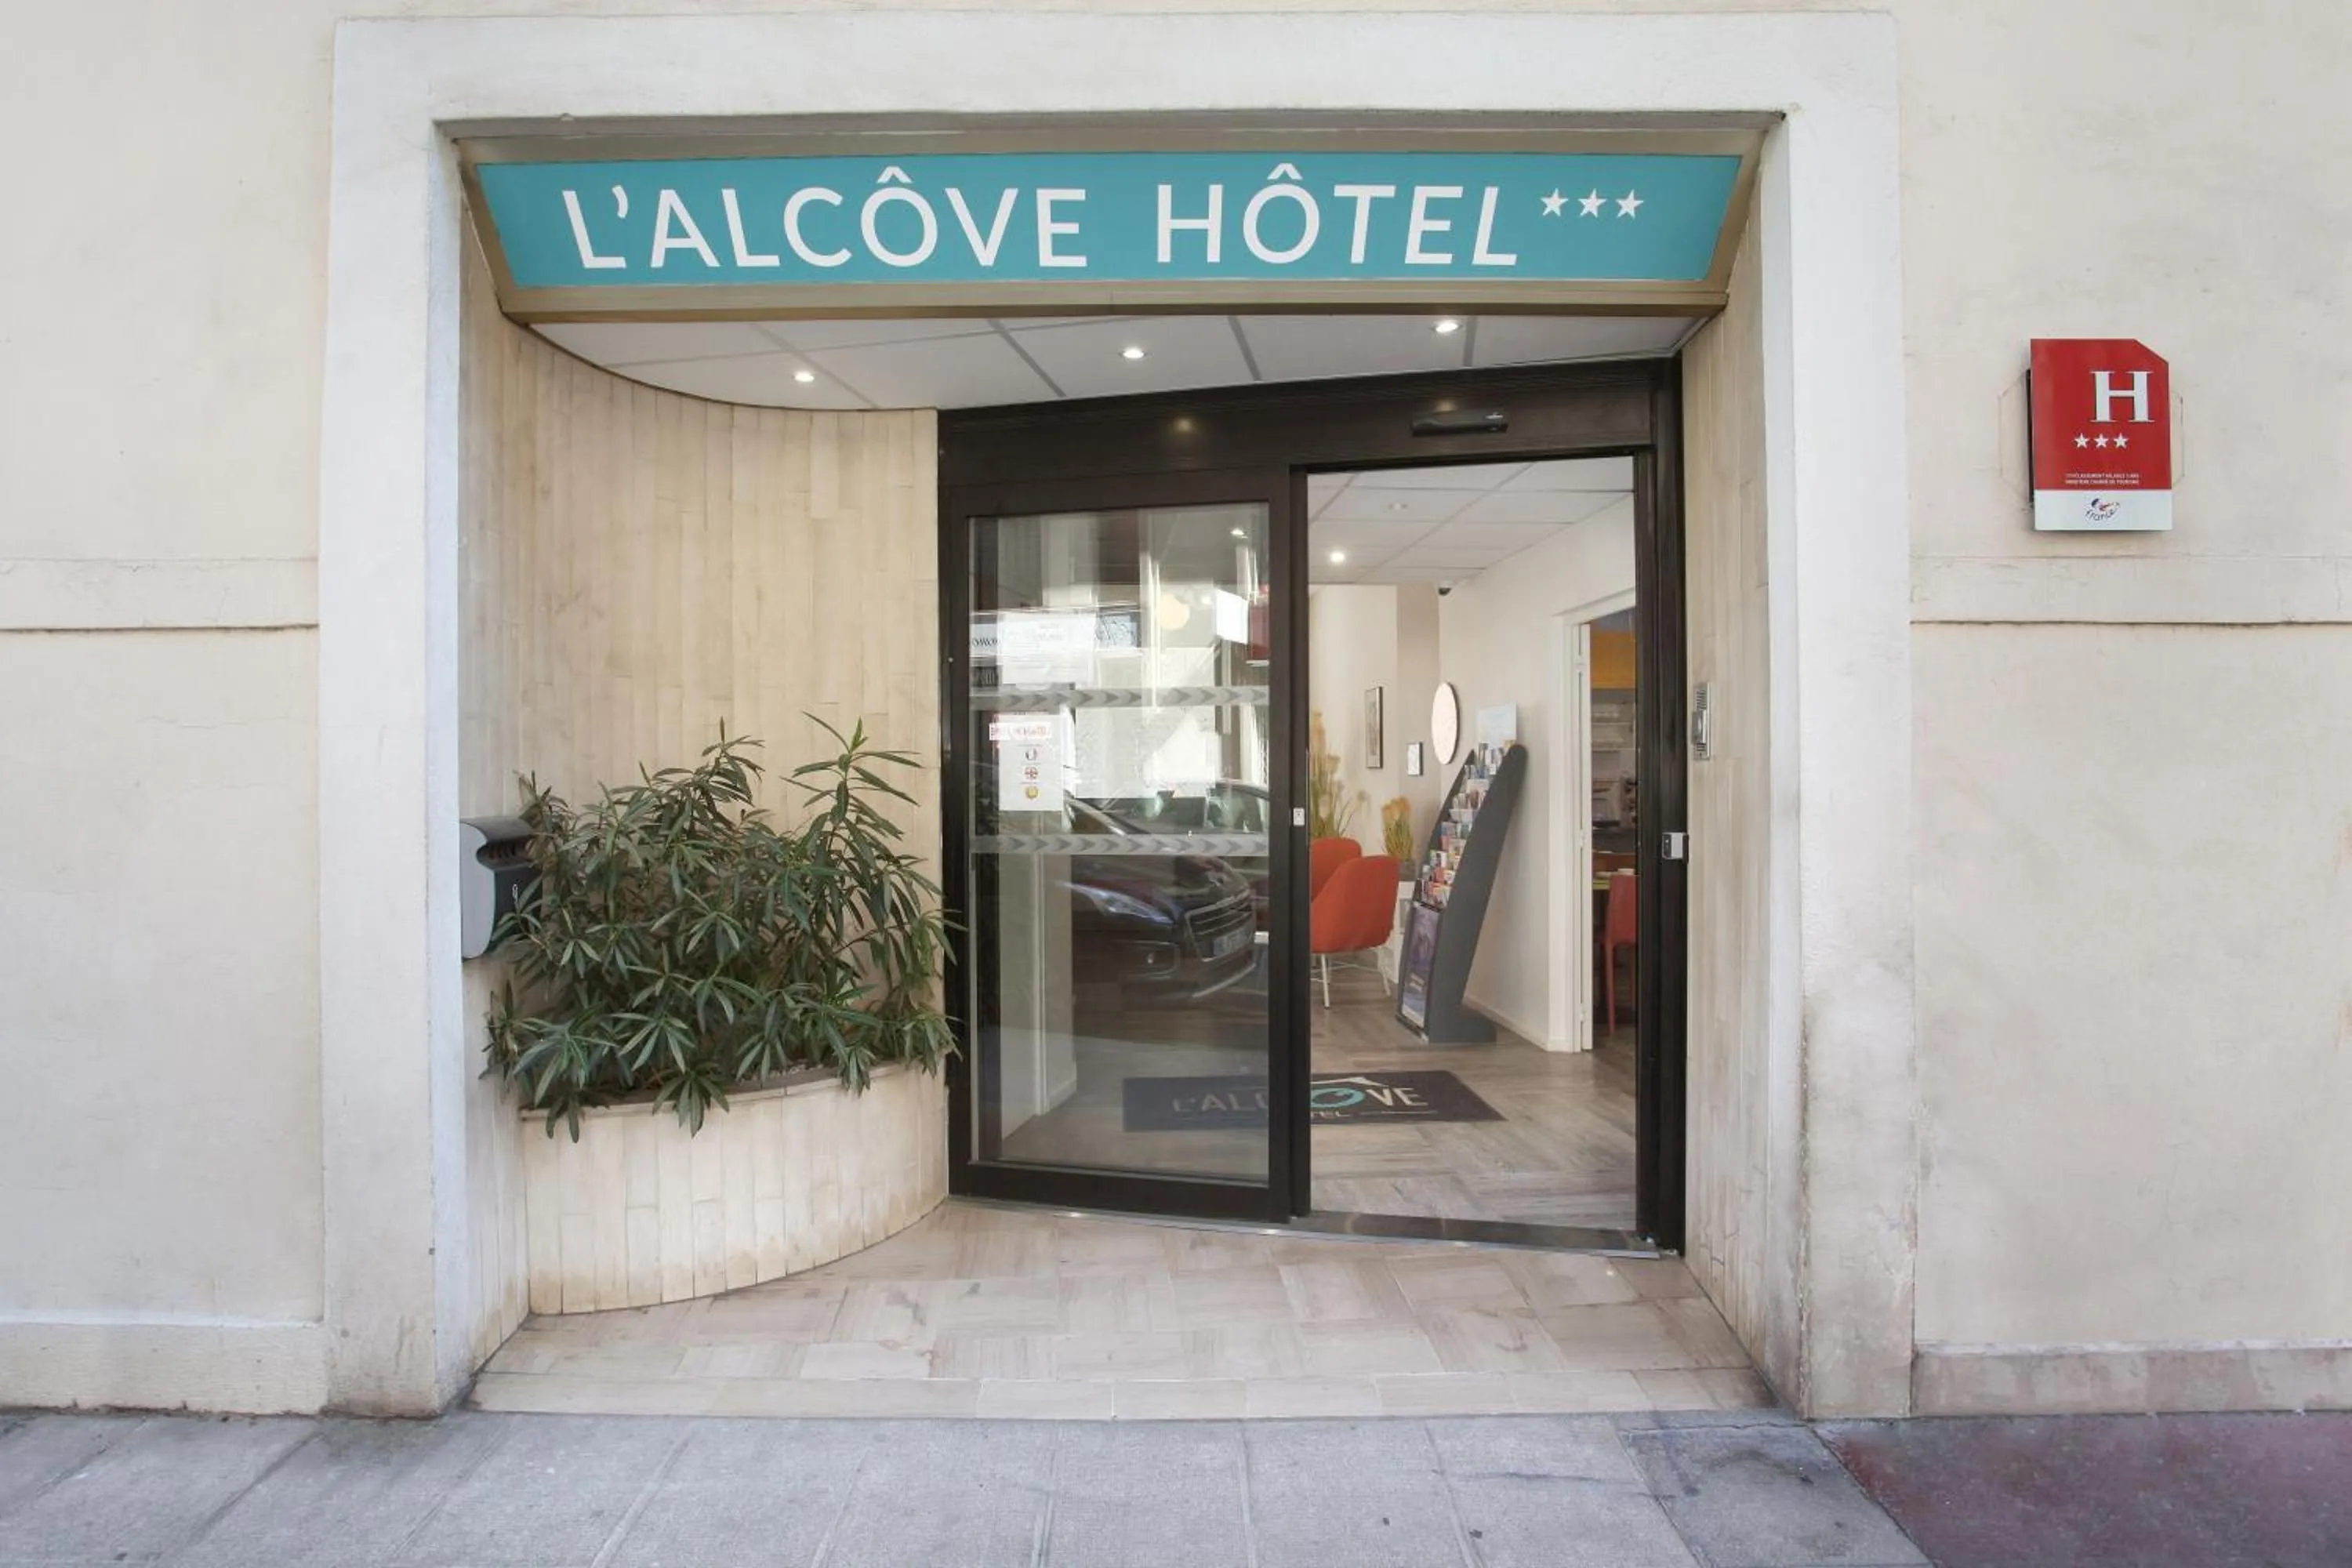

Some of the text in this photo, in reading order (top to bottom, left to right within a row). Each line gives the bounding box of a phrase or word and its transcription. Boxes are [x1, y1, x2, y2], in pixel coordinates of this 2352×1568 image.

[562, 162, 1518, 268] L'ALCÔVE HÔTEL
[2088, 371, 2155, 423] H
